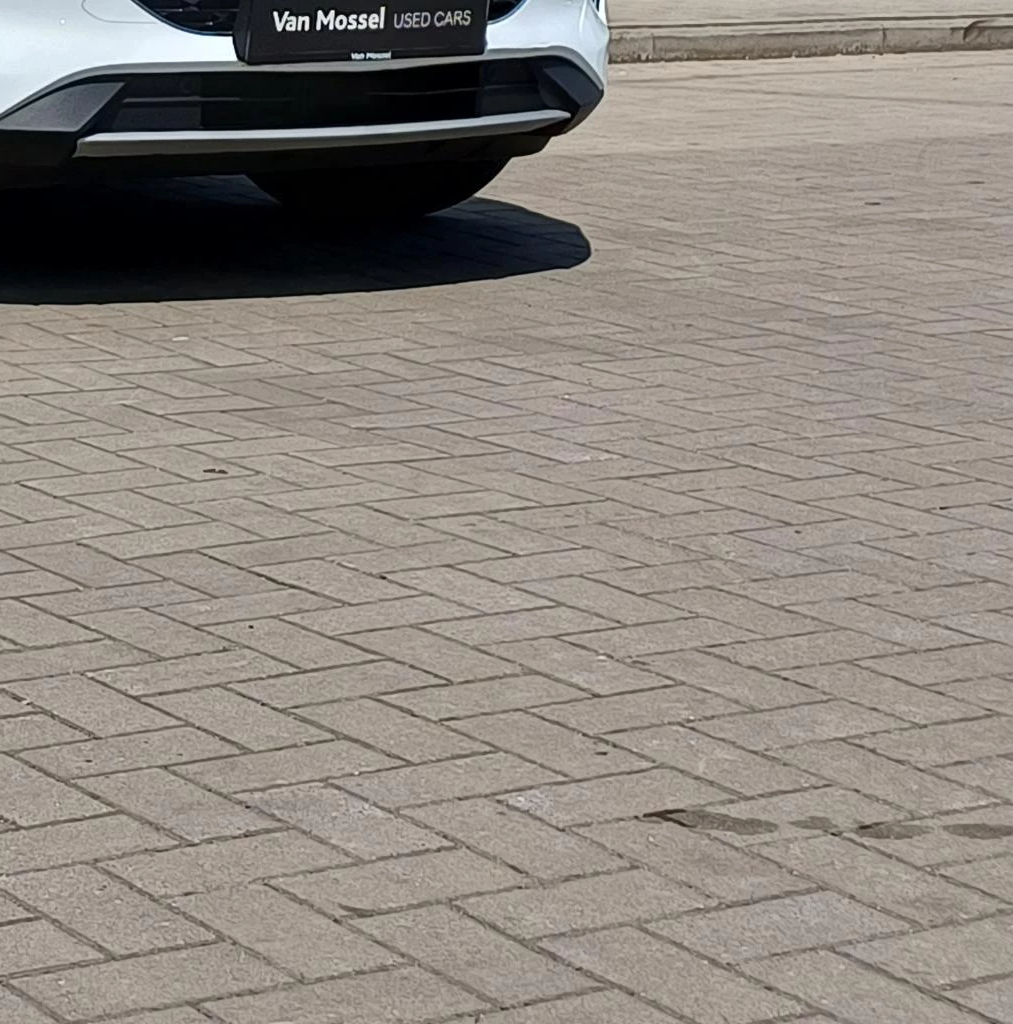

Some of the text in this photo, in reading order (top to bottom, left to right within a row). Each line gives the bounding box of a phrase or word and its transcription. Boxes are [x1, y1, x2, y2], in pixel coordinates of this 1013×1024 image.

[273, 6, 472, 32] Van Mossel USED CARS
